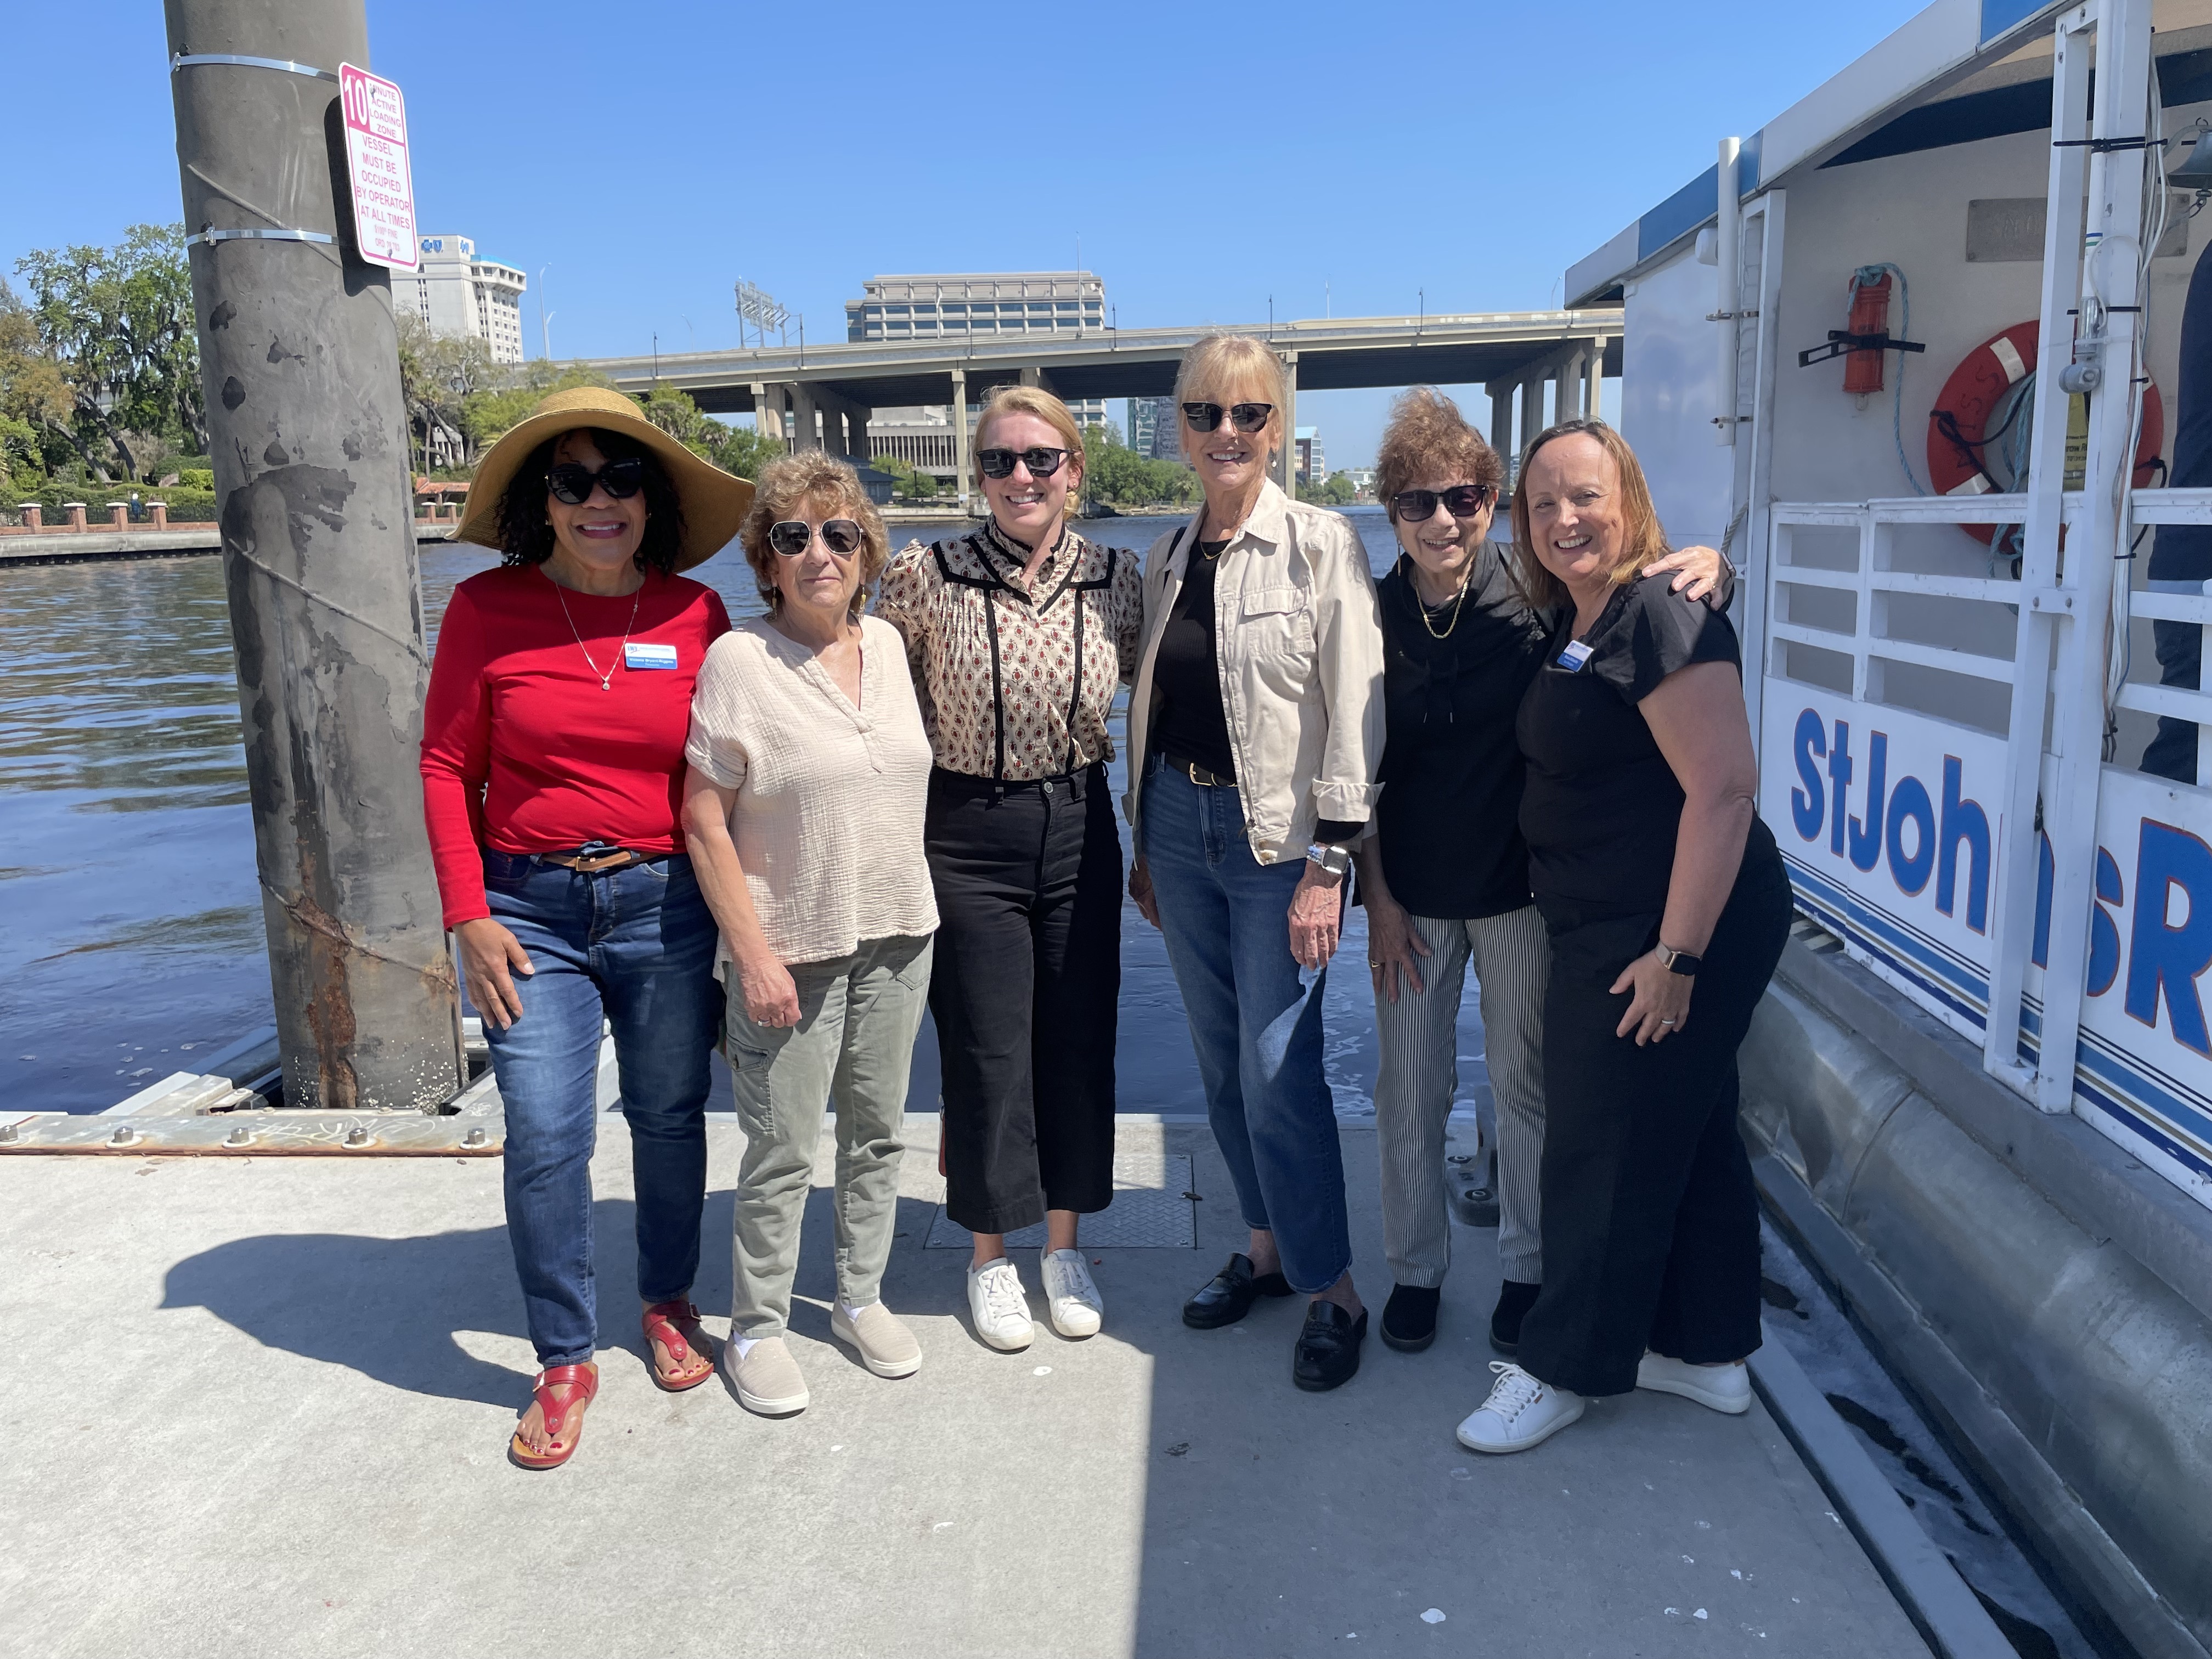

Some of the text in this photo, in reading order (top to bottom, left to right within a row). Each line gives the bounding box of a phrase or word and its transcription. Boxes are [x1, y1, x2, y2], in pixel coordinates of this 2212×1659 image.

[345, 75, 367, 126] 10
[372, 98, 397, 114] ACTIVE
[369, 107, 402, 127] LOADING
[377, 123, 396, 138] ZONE
[362, 134, 393, 156] VESSEL
[363, 152, 397, 174] MUST BE
[362, 170, 401, 193] OCCUPIED
[357, 186, 410, 212] BY OPERATOR
[360, 205, 410, 230] AT ALL TIMES
[387, 228, 398, 239] FINE
